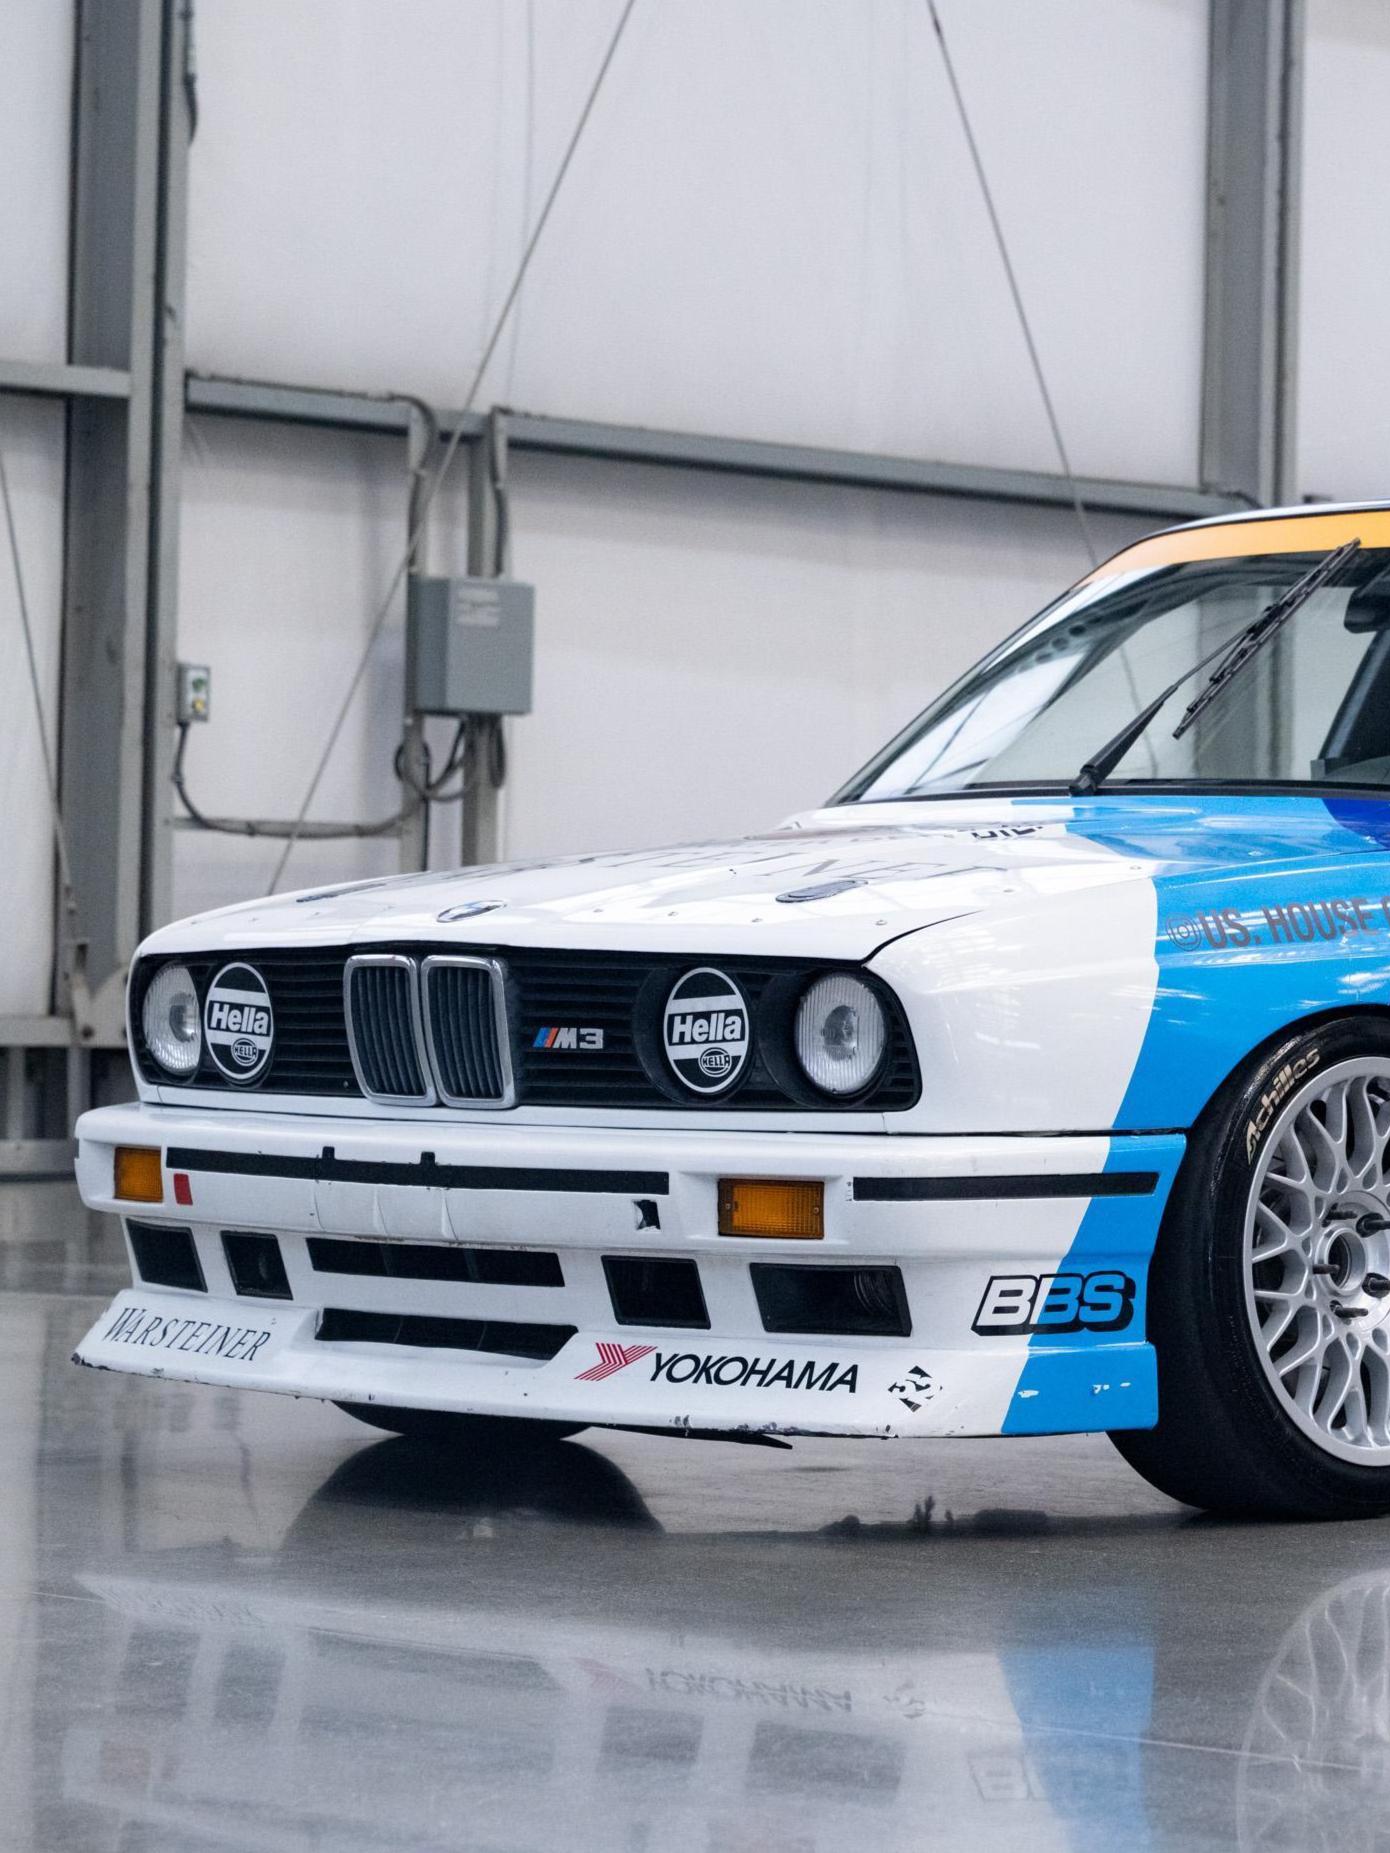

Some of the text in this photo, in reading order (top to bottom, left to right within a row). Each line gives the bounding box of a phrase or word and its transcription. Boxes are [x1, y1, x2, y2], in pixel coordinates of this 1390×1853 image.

[1262, 897, 1378, 943] HOUSE
[209, 1002, 270, 1036] Hella
[671, 1012, 742, 1044] Hella
[234, 1044, 258, 1059] HELLA
[702, 1055, 731, 1068] HELLA
[1246, 1048, 1320, 1165] Achilles
[970, 1270, 1137, 1337] BBS
[102, 1307, 272, 1362] WARSTEINER
[649, 1352, 860, 1394] YOKOHAMA
